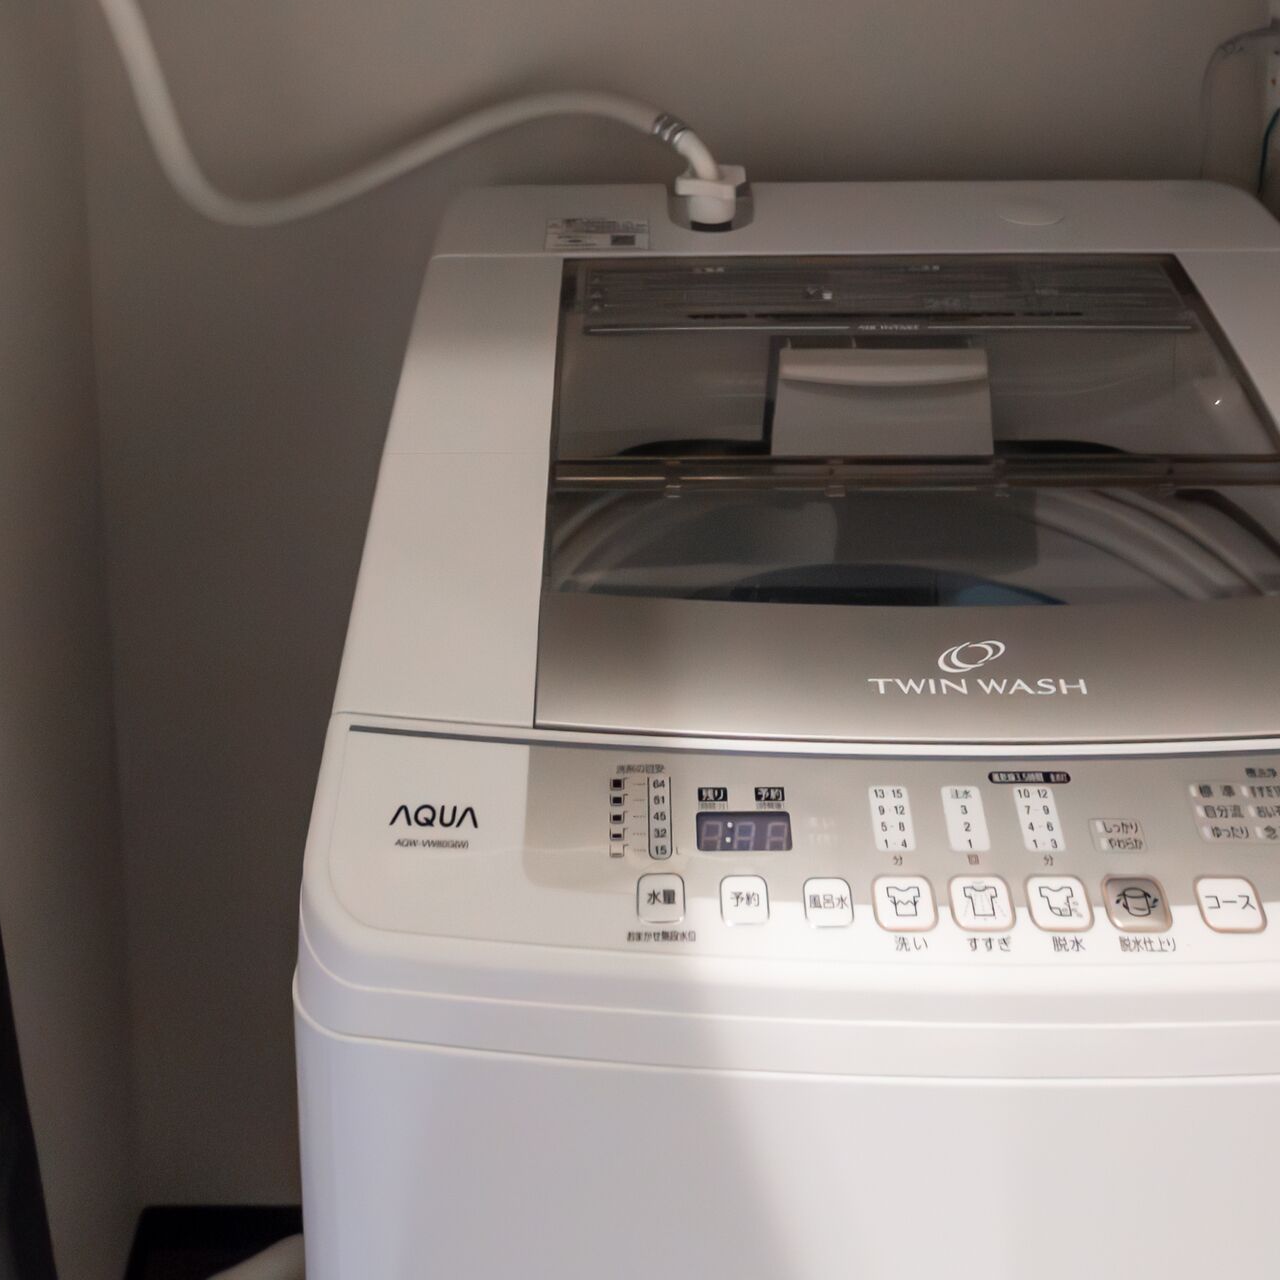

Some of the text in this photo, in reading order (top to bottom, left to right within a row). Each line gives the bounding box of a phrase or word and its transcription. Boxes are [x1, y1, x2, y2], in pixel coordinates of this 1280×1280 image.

[867, 678, 1088, 695] TWIN WASH
[652, 779, 665, 789] 64
[874, 789, 903, 799] 13 15
[1017, 789, 1048, 799] 10 12
[389, 804, 479, 829] AQUA
[878, 805, 905, 816] 9 12
[960, 805, 968, 815] 3
[1024, 805, 1050, 816] 7 9
[963, 822, 971, 832] 2
[1027, 822, 1054, 832] 4 6
[900, 839, 908, 849] 4
[1050, 839, 1058, 849] 3
[646, 889, 677, 905] 水量
[730, 891, 761, 908] 予約
[809, 894, 849, 910] 風呂水
[1204, 894, 1257, 911] コース
[894, 936, 929, 953] 洗い
[967, 936, 1012, 953] すすぎ
[1052, 935, 1087, 953] 脱水
[1120, 935, 1177, 953] 脱水仕上り
